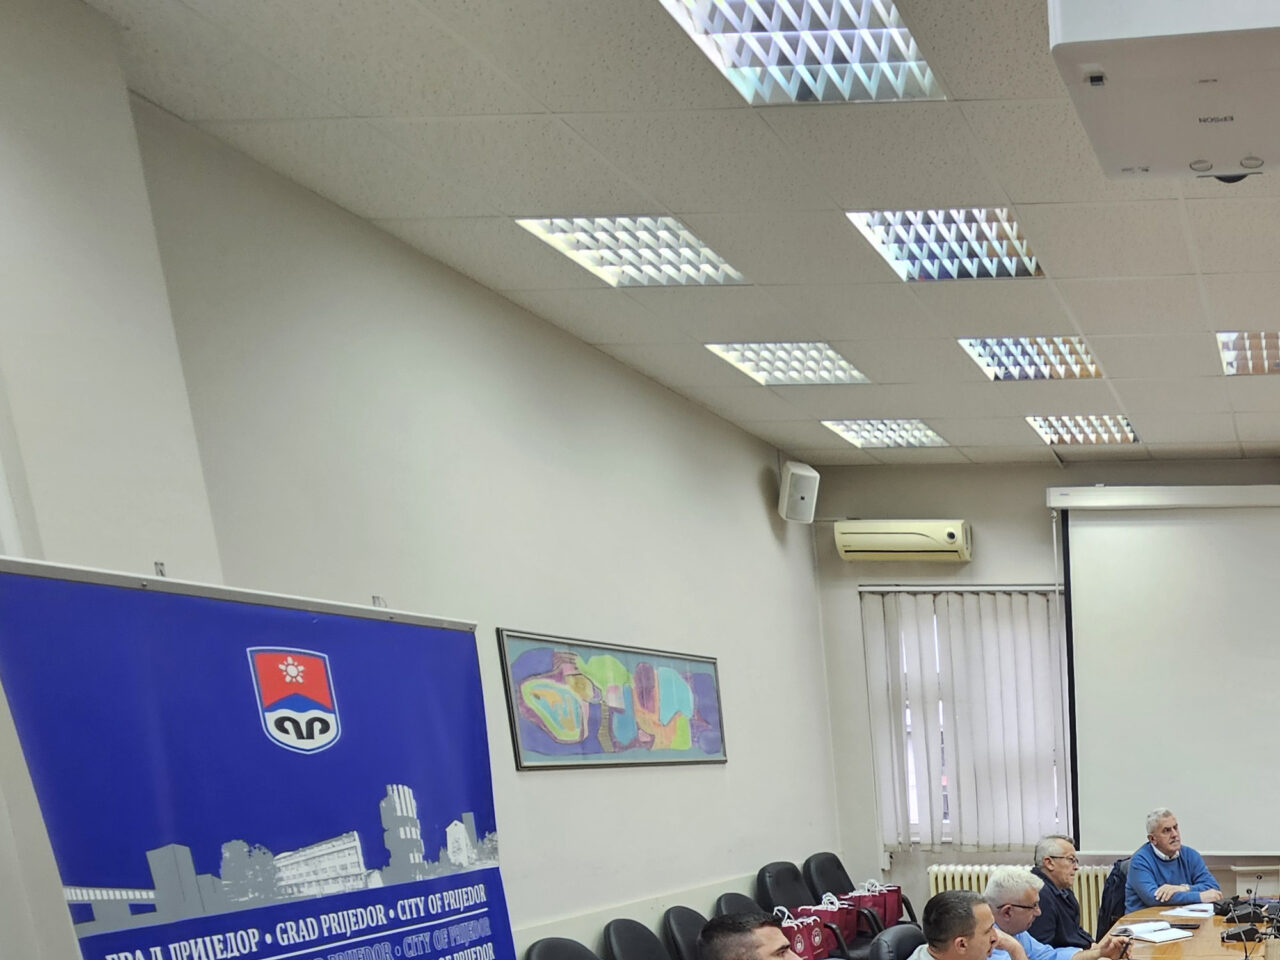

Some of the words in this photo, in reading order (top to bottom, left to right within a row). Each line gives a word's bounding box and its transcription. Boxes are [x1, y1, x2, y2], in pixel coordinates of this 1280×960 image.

[276, 918, 319, 946] GRAD
[320, 904, 387, 937] PRIJEDOR
[396, 897, 425, 921] CITY
[428, 893, 444, 914] OF
[444, 883, 487, 912] PRIJEDOR
[403, 932, 431, 958] CITY
[433, 929, 449, 950] OF
